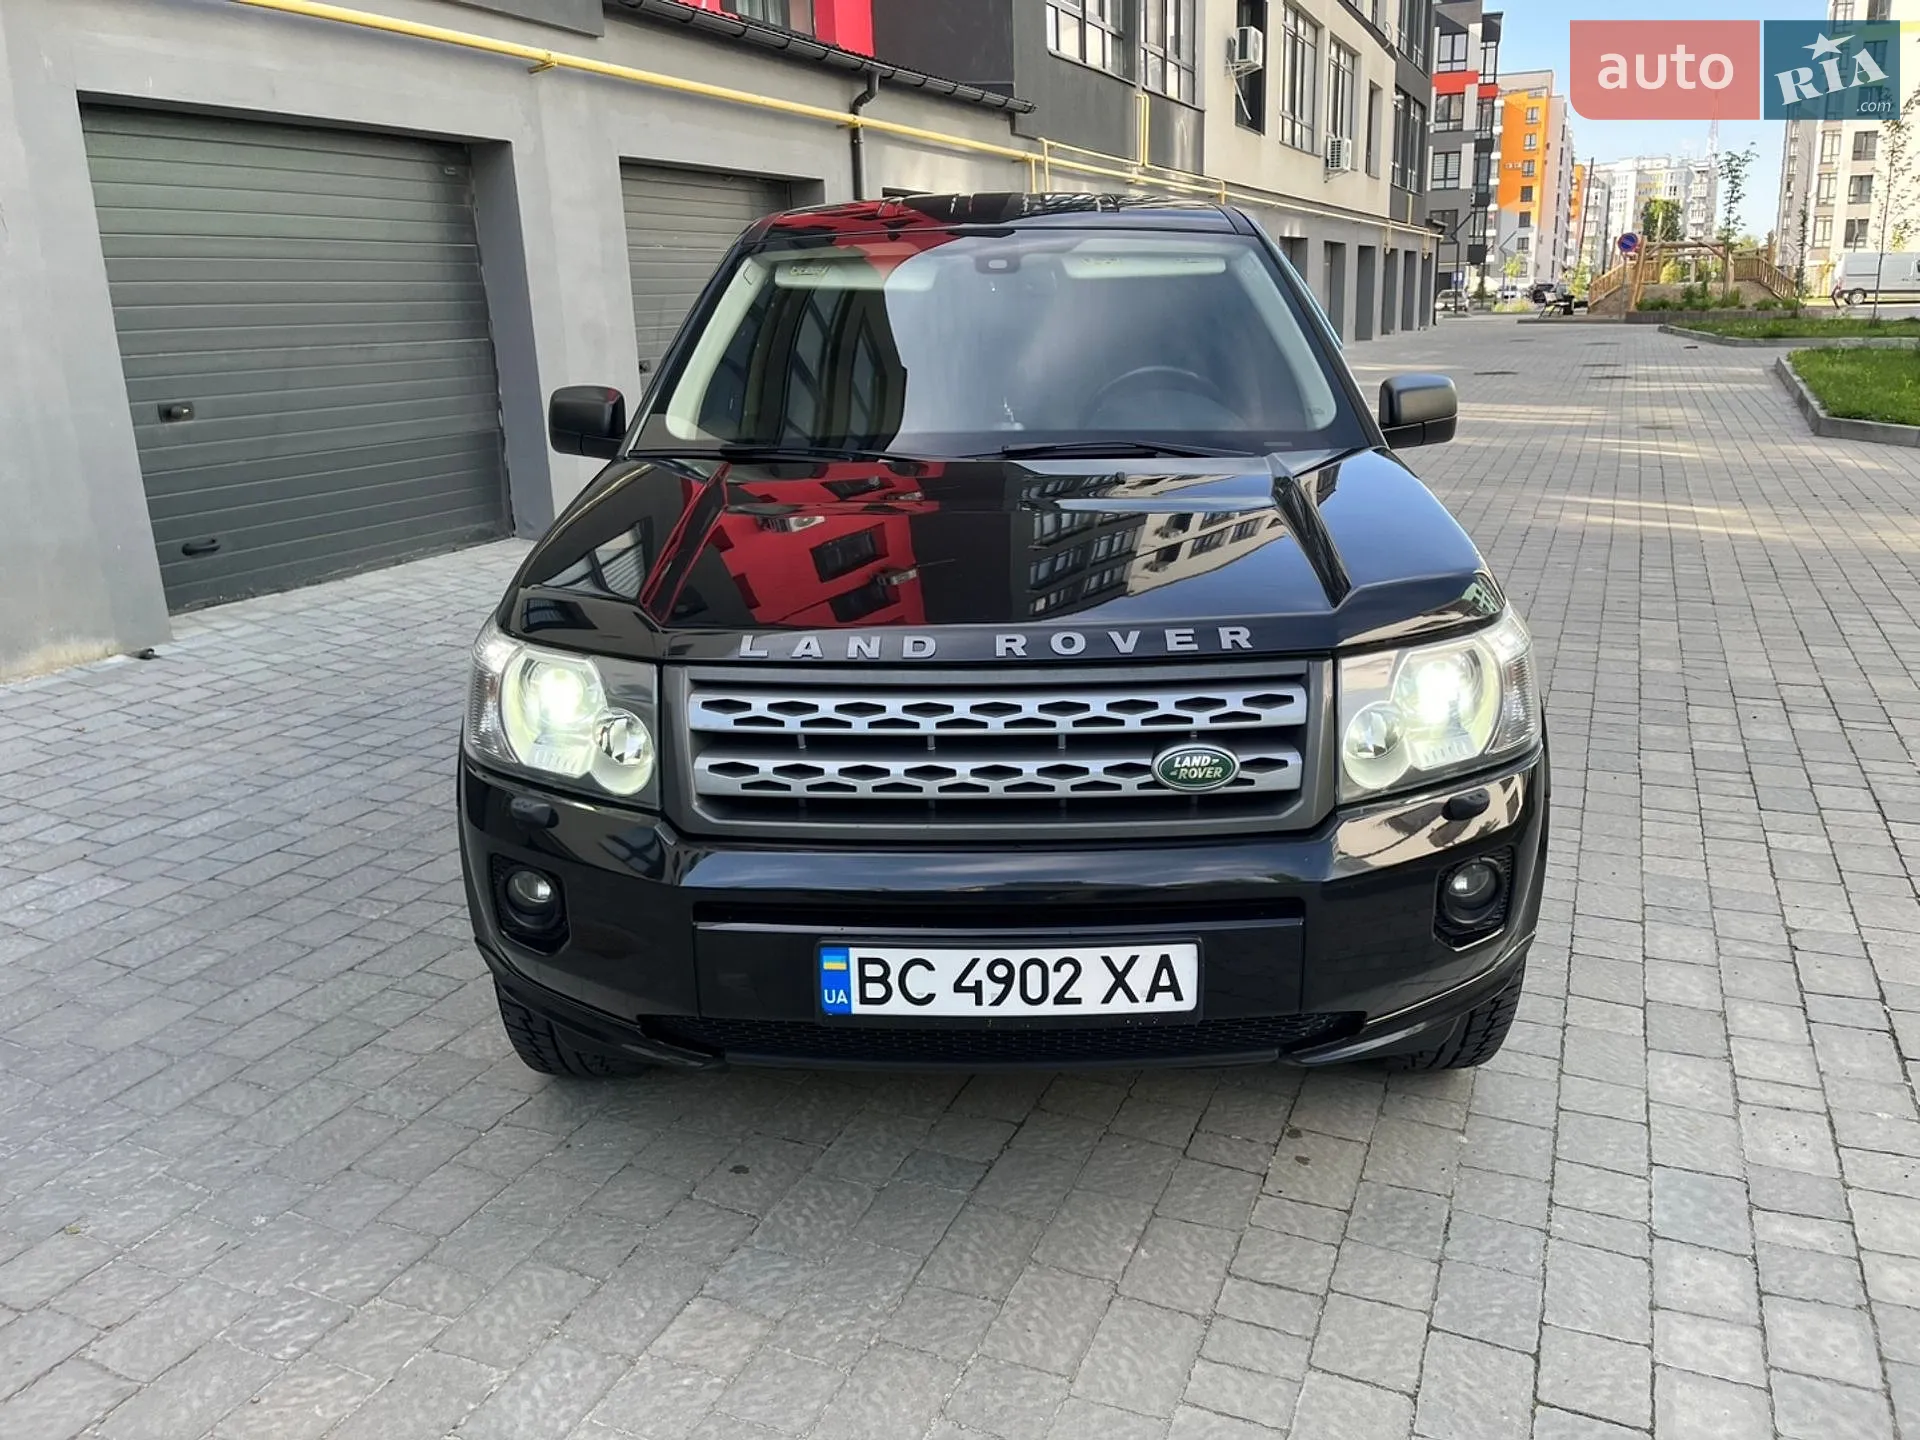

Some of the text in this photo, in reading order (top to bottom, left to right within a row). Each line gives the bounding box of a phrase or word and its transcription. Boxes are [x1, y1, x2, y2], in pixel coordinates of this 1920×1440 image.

[738, 625, 1254, 660] LAND ROVER
[824, 989, 848, 1005] UA
[857, 953, 1184, 1007] BC 4902 XA
